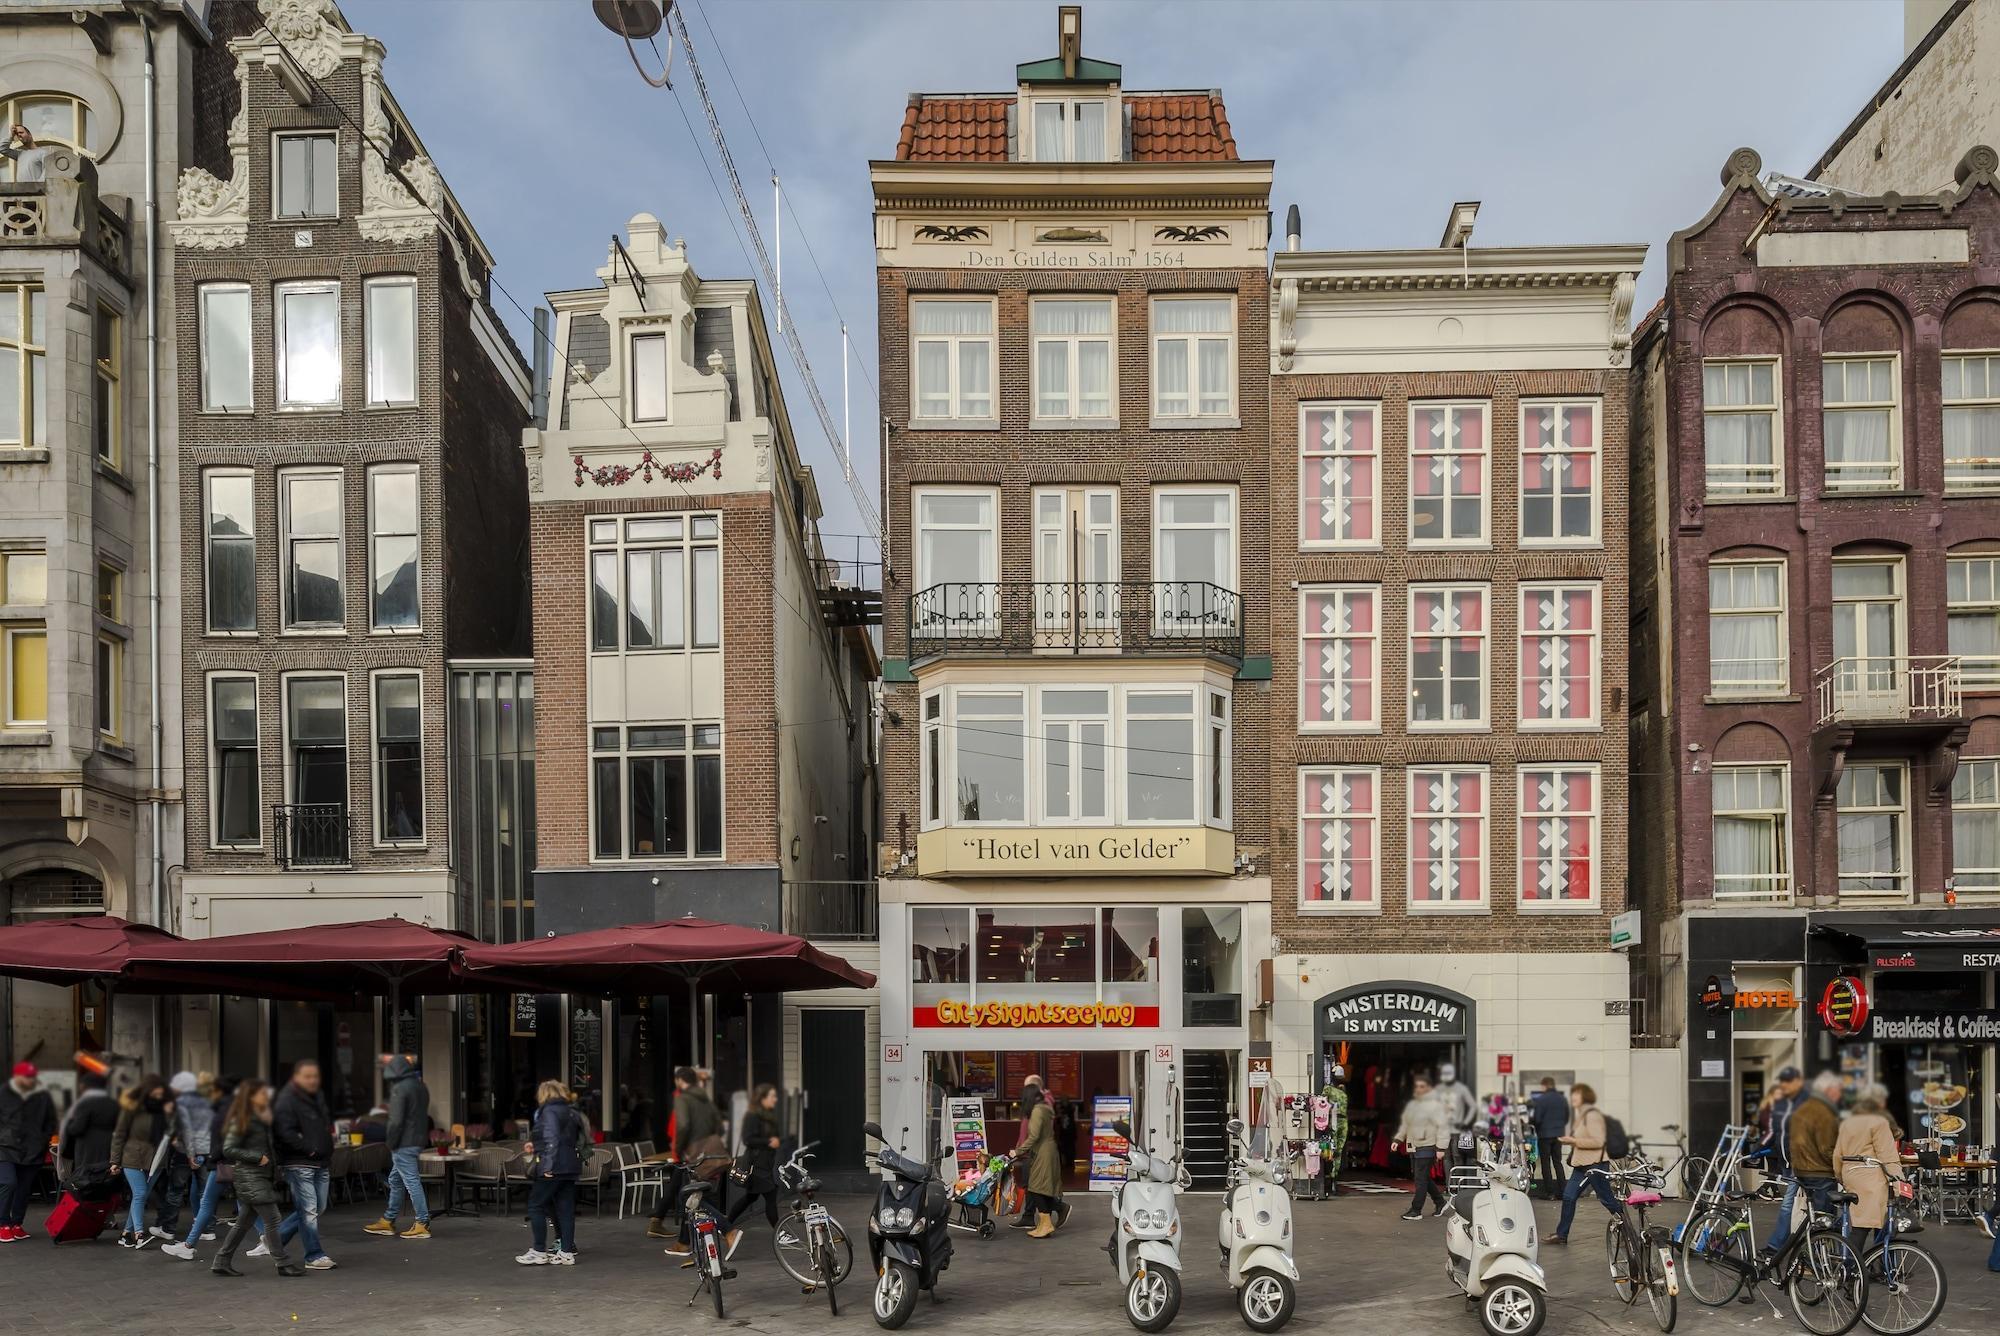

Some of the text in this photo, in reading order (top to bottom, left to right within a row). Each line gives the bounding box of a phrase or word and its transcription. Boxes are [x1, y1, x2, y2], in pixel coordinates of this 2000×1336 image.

[1014, 251, 1078, 267] Gulden
[1144, 251, 1185, 267] 1564
[963, 837, 1190, 860] “Hotel van Gelder”
[1876, 957, 1916, 967] ALLSTARS
[1702, 992, 1721, 1003] HOTEL
[1734, 991, 1799, 1009] HOTEL
[1327, 993, 1458, 1024] AMSTERDAM
[1344, 1019, 1440, 1033] IS MY STYLE
[1872, 1015, 1941, 1039] Breakfast
[1943, 1015, 1955, 1039] &
[639, 1015, 648, 1058] ALLEY
[574, 1021, 588, 1088] RAGAZZI
[888, 1048, 899, 1058] 34
[1158, 1049, 1169, 1058] 34
[1253, 1060, 1268, 1072] 34
